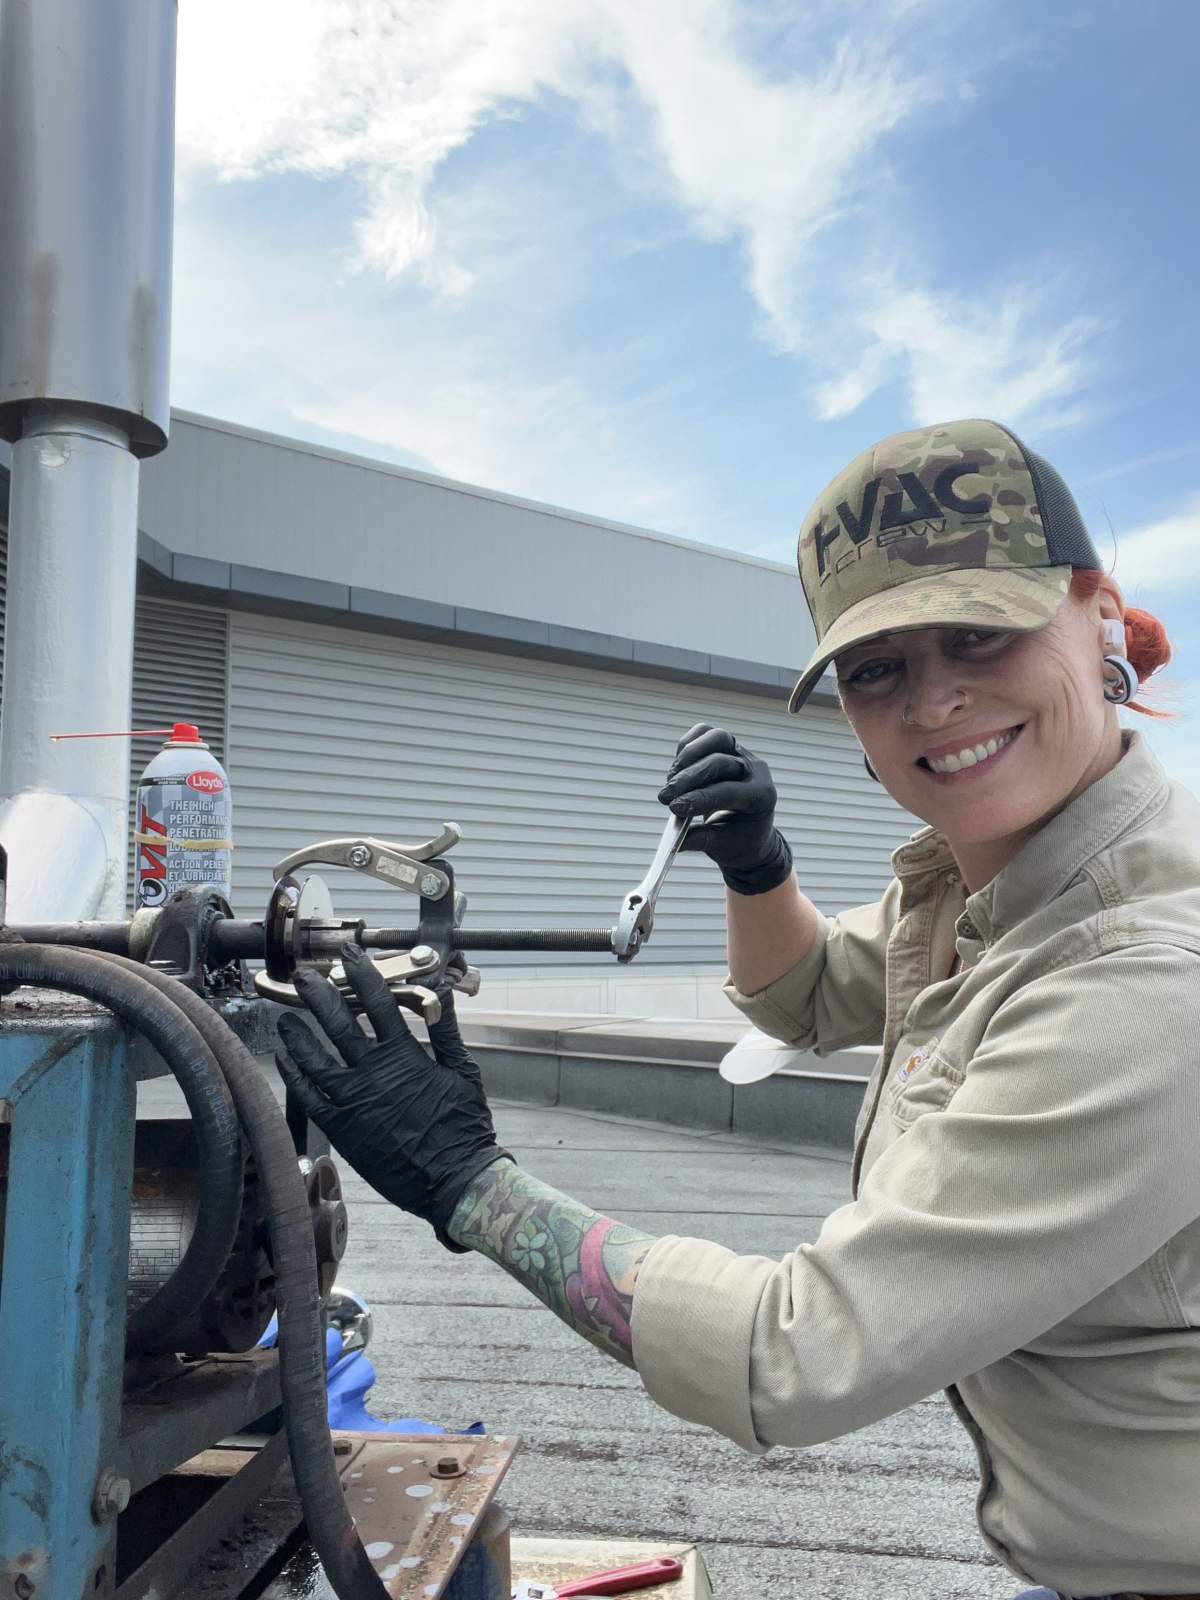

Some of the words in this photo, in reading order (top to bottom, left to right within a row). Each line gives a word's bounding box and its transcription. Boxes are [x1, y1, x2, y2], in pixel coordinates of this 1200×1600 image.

[814, 462, 993, 578] HVAC
[192, 774, 223, 790] Lloyds
[169, 800, 189, 811] THE
[191, 800, 215, 811] HIGH
[168, 860, 201, 869] ACTION
[169, 872, 179, 881] ET
